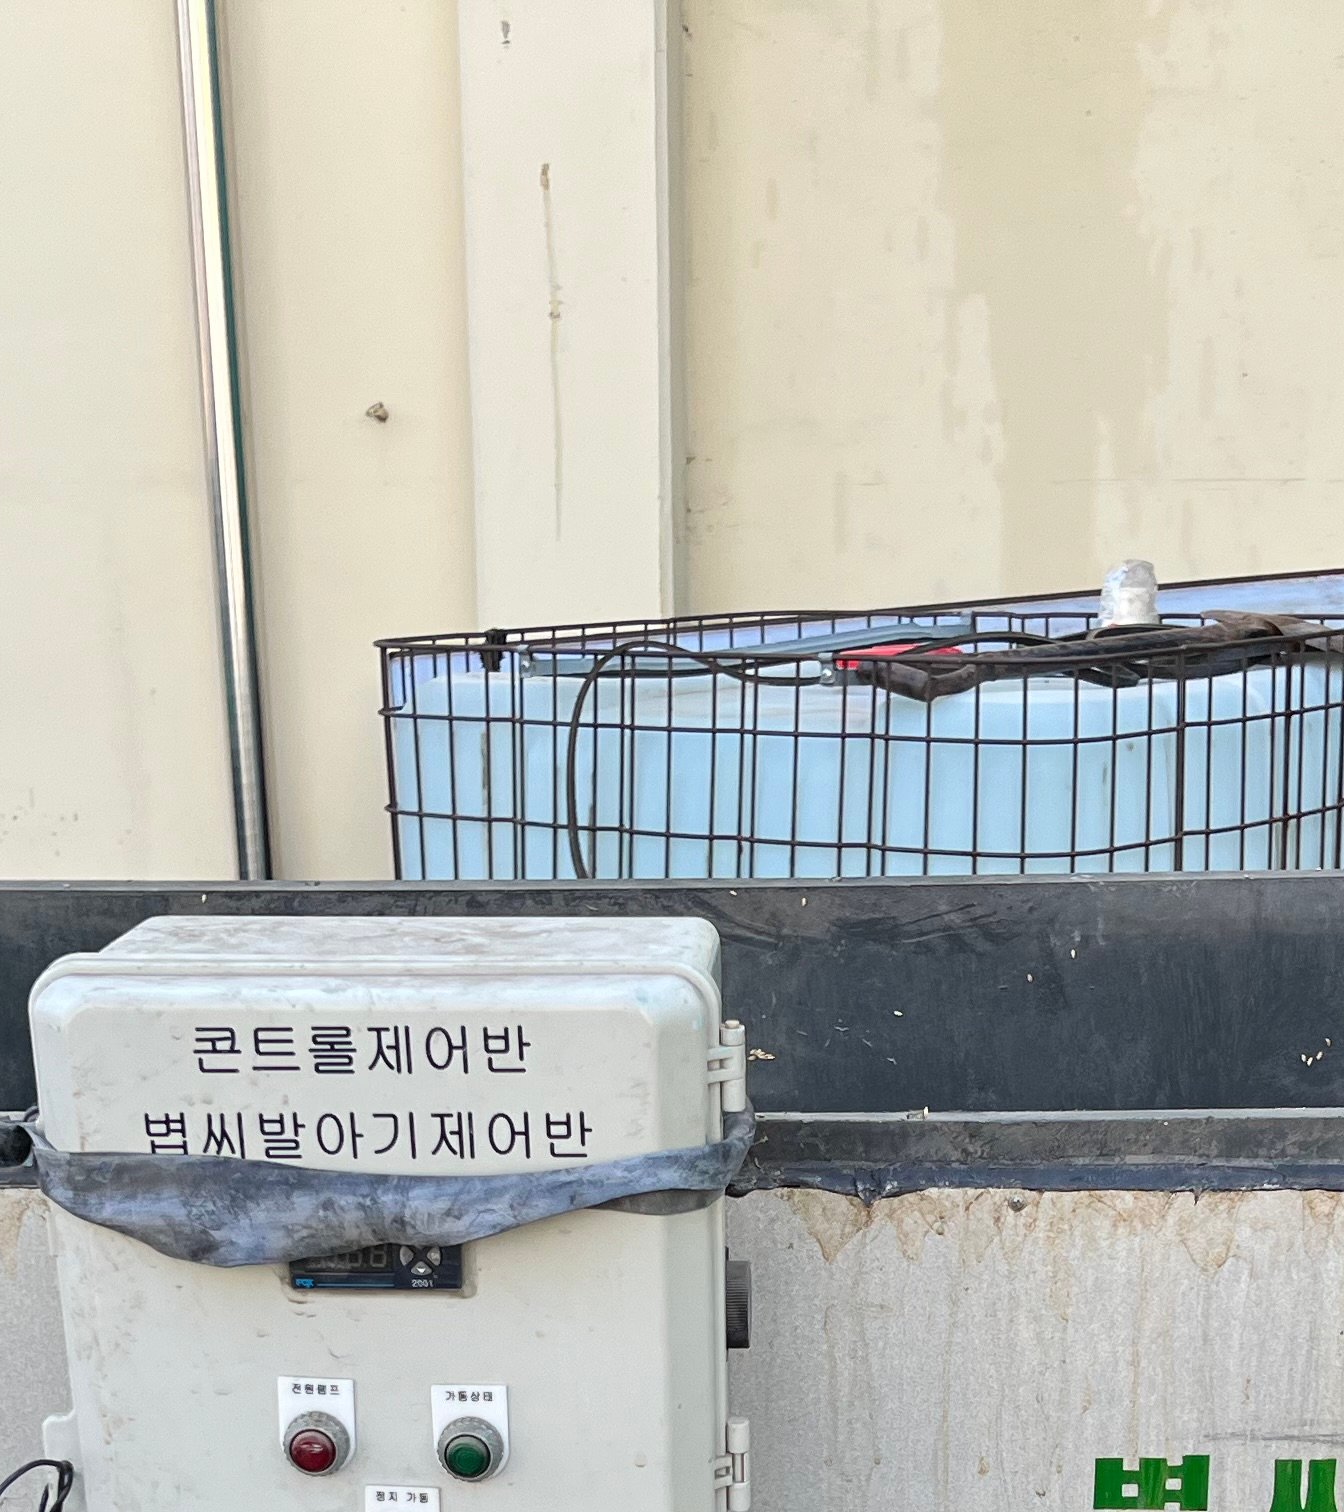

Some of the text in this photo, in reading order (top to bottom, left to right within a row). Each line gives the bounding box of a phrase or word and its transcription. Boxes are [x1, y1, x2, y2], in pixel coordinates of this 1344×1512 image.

[192, 1026, 531, 1074] 콘트롤제어반
[144, 1112, 592, 1160] 볍씨발아기제어반
[292, 1384, 340, 1395] 전원램프
[446, 1391, 493, 1402] 가동상태
